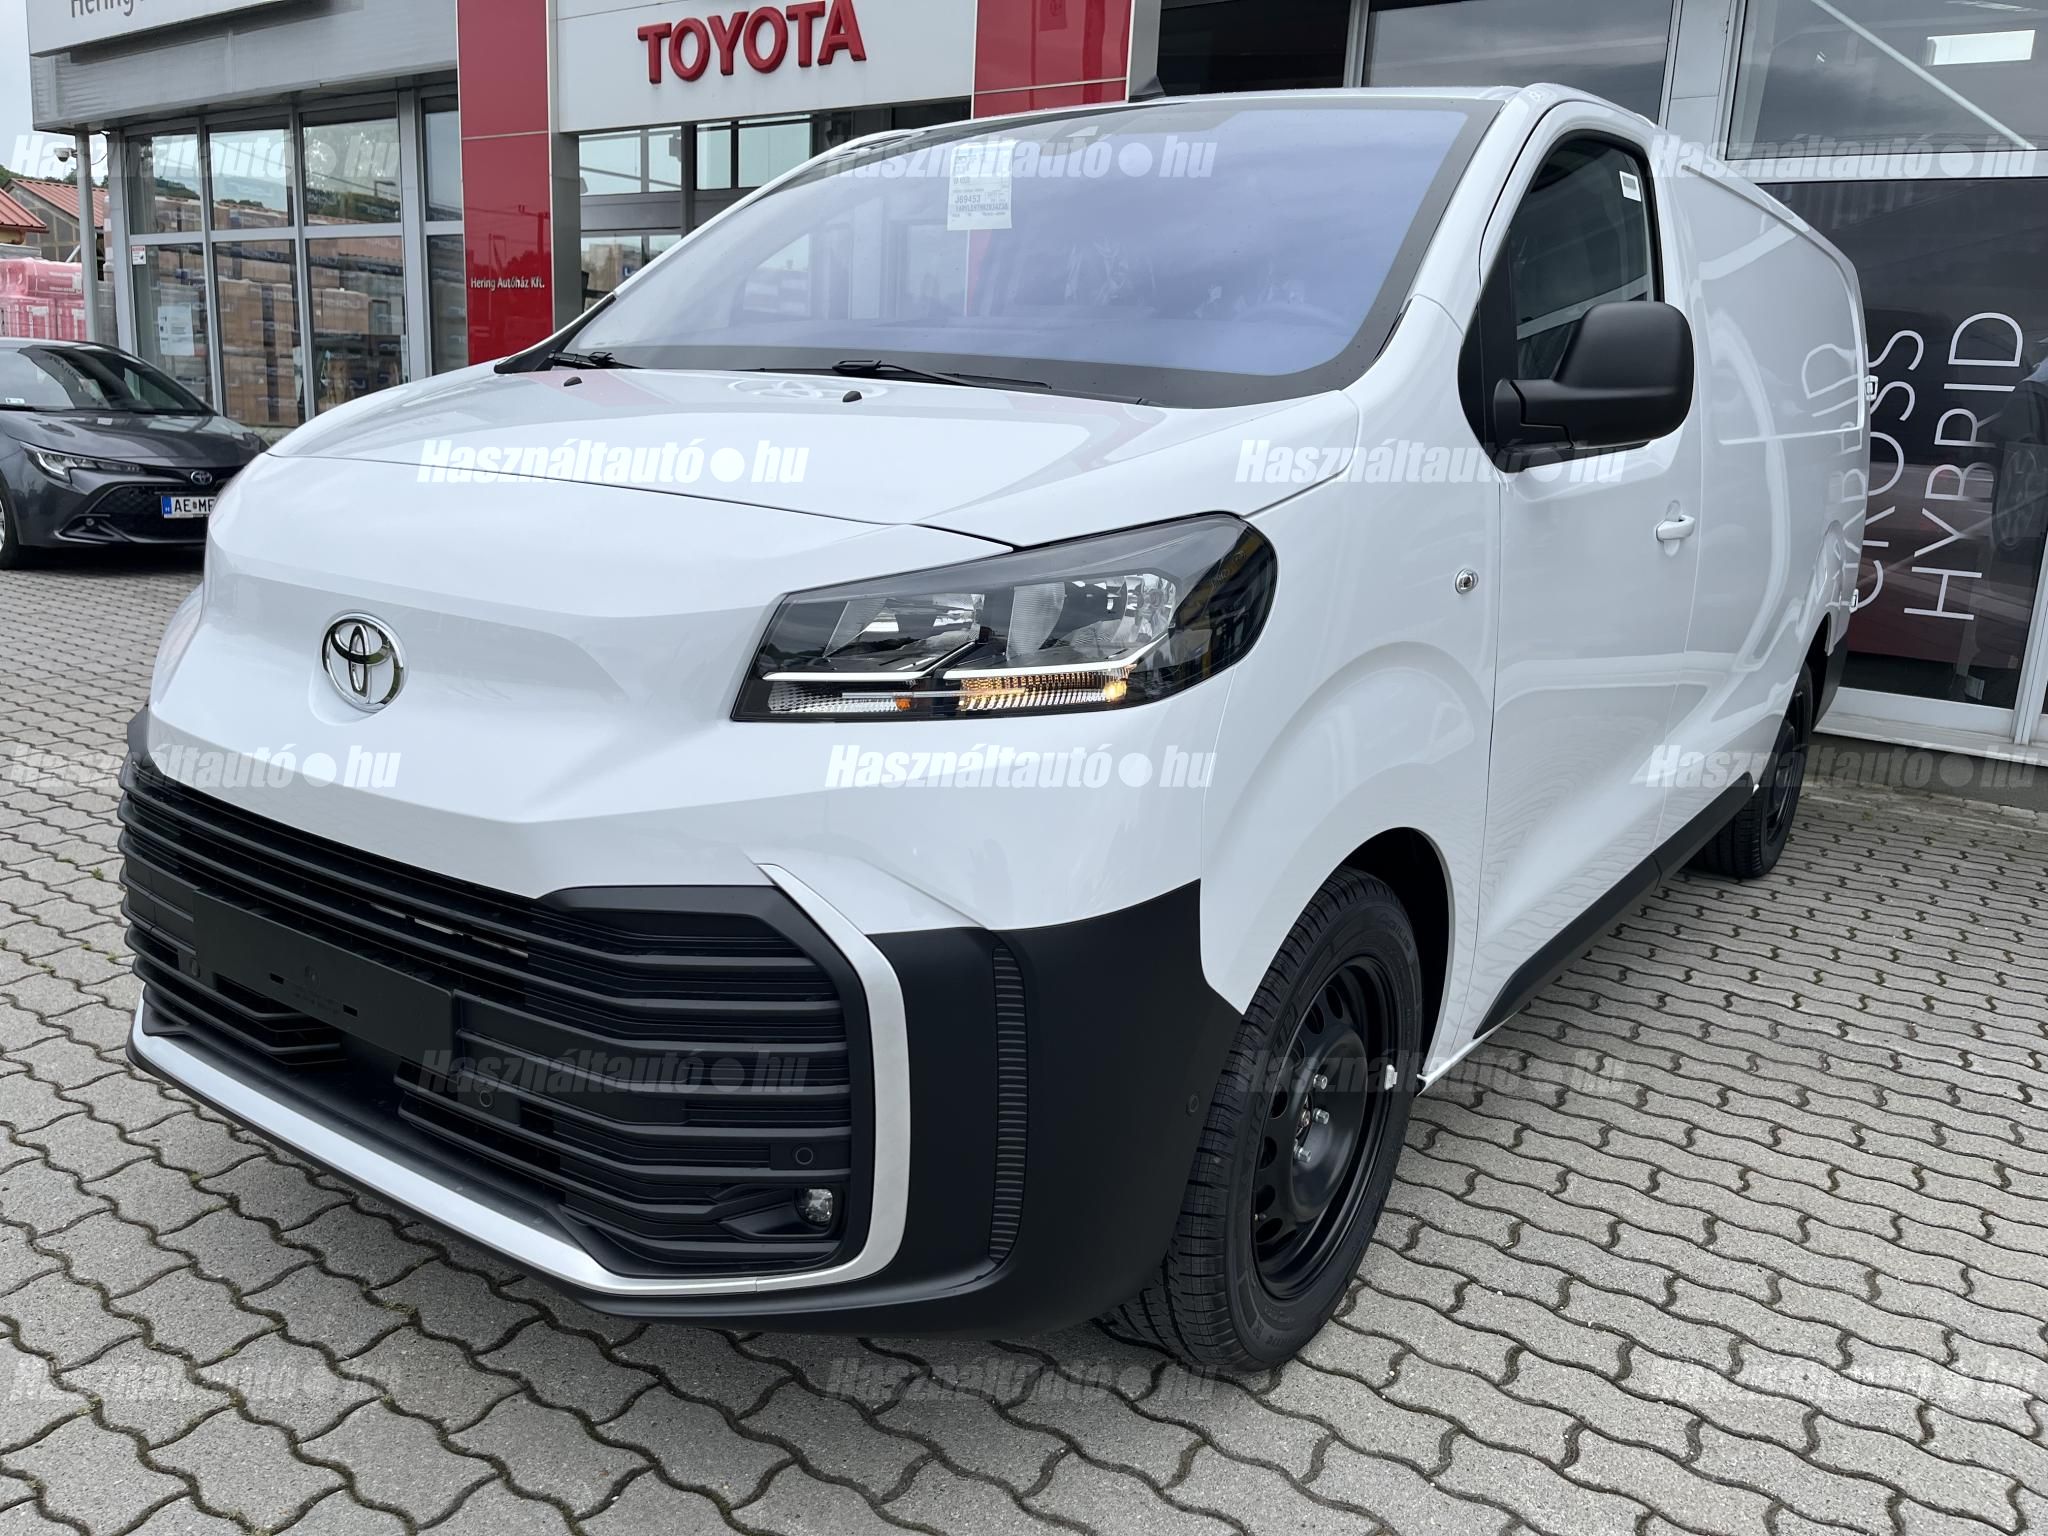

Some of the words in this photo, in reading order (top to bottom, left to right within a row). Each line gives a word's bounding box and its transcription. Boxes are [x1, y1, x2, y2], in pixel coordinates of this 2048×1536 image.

[638, 0, 867, 84] TOYOTA
[470, 277, 496, 291] Hering
[497, 276, 529, 289] Autóház
[1904, 312, 2023, 620] HYBRID
[174, 499, 192, 512] AE
